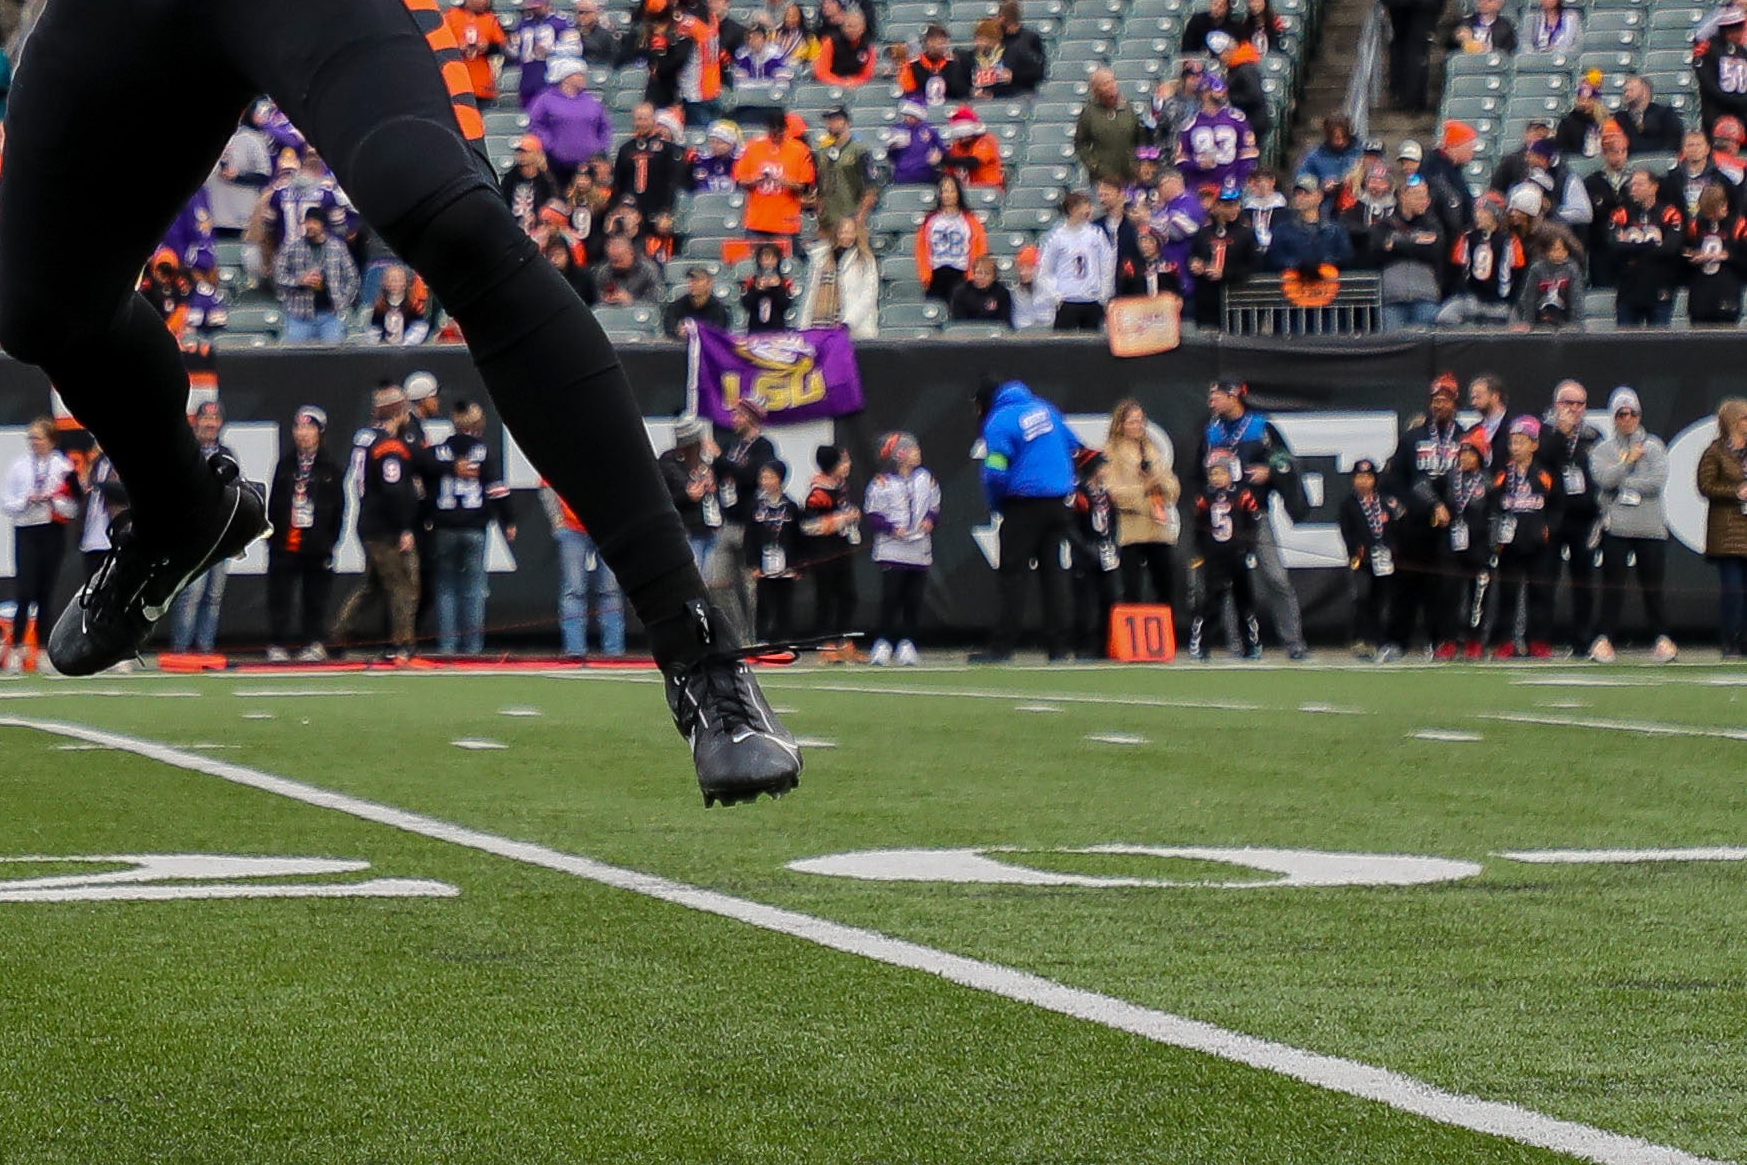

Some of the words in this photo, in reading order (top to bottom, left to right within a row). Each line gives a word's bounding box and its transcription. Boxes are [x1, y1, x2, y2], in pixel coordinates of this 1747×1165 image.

[571, 207, 591, 239] 9
[721, 367, 825, 413] LSU
[1210, 503, 1234, 542] 5
[1126, 616, 1166, 657] 10
